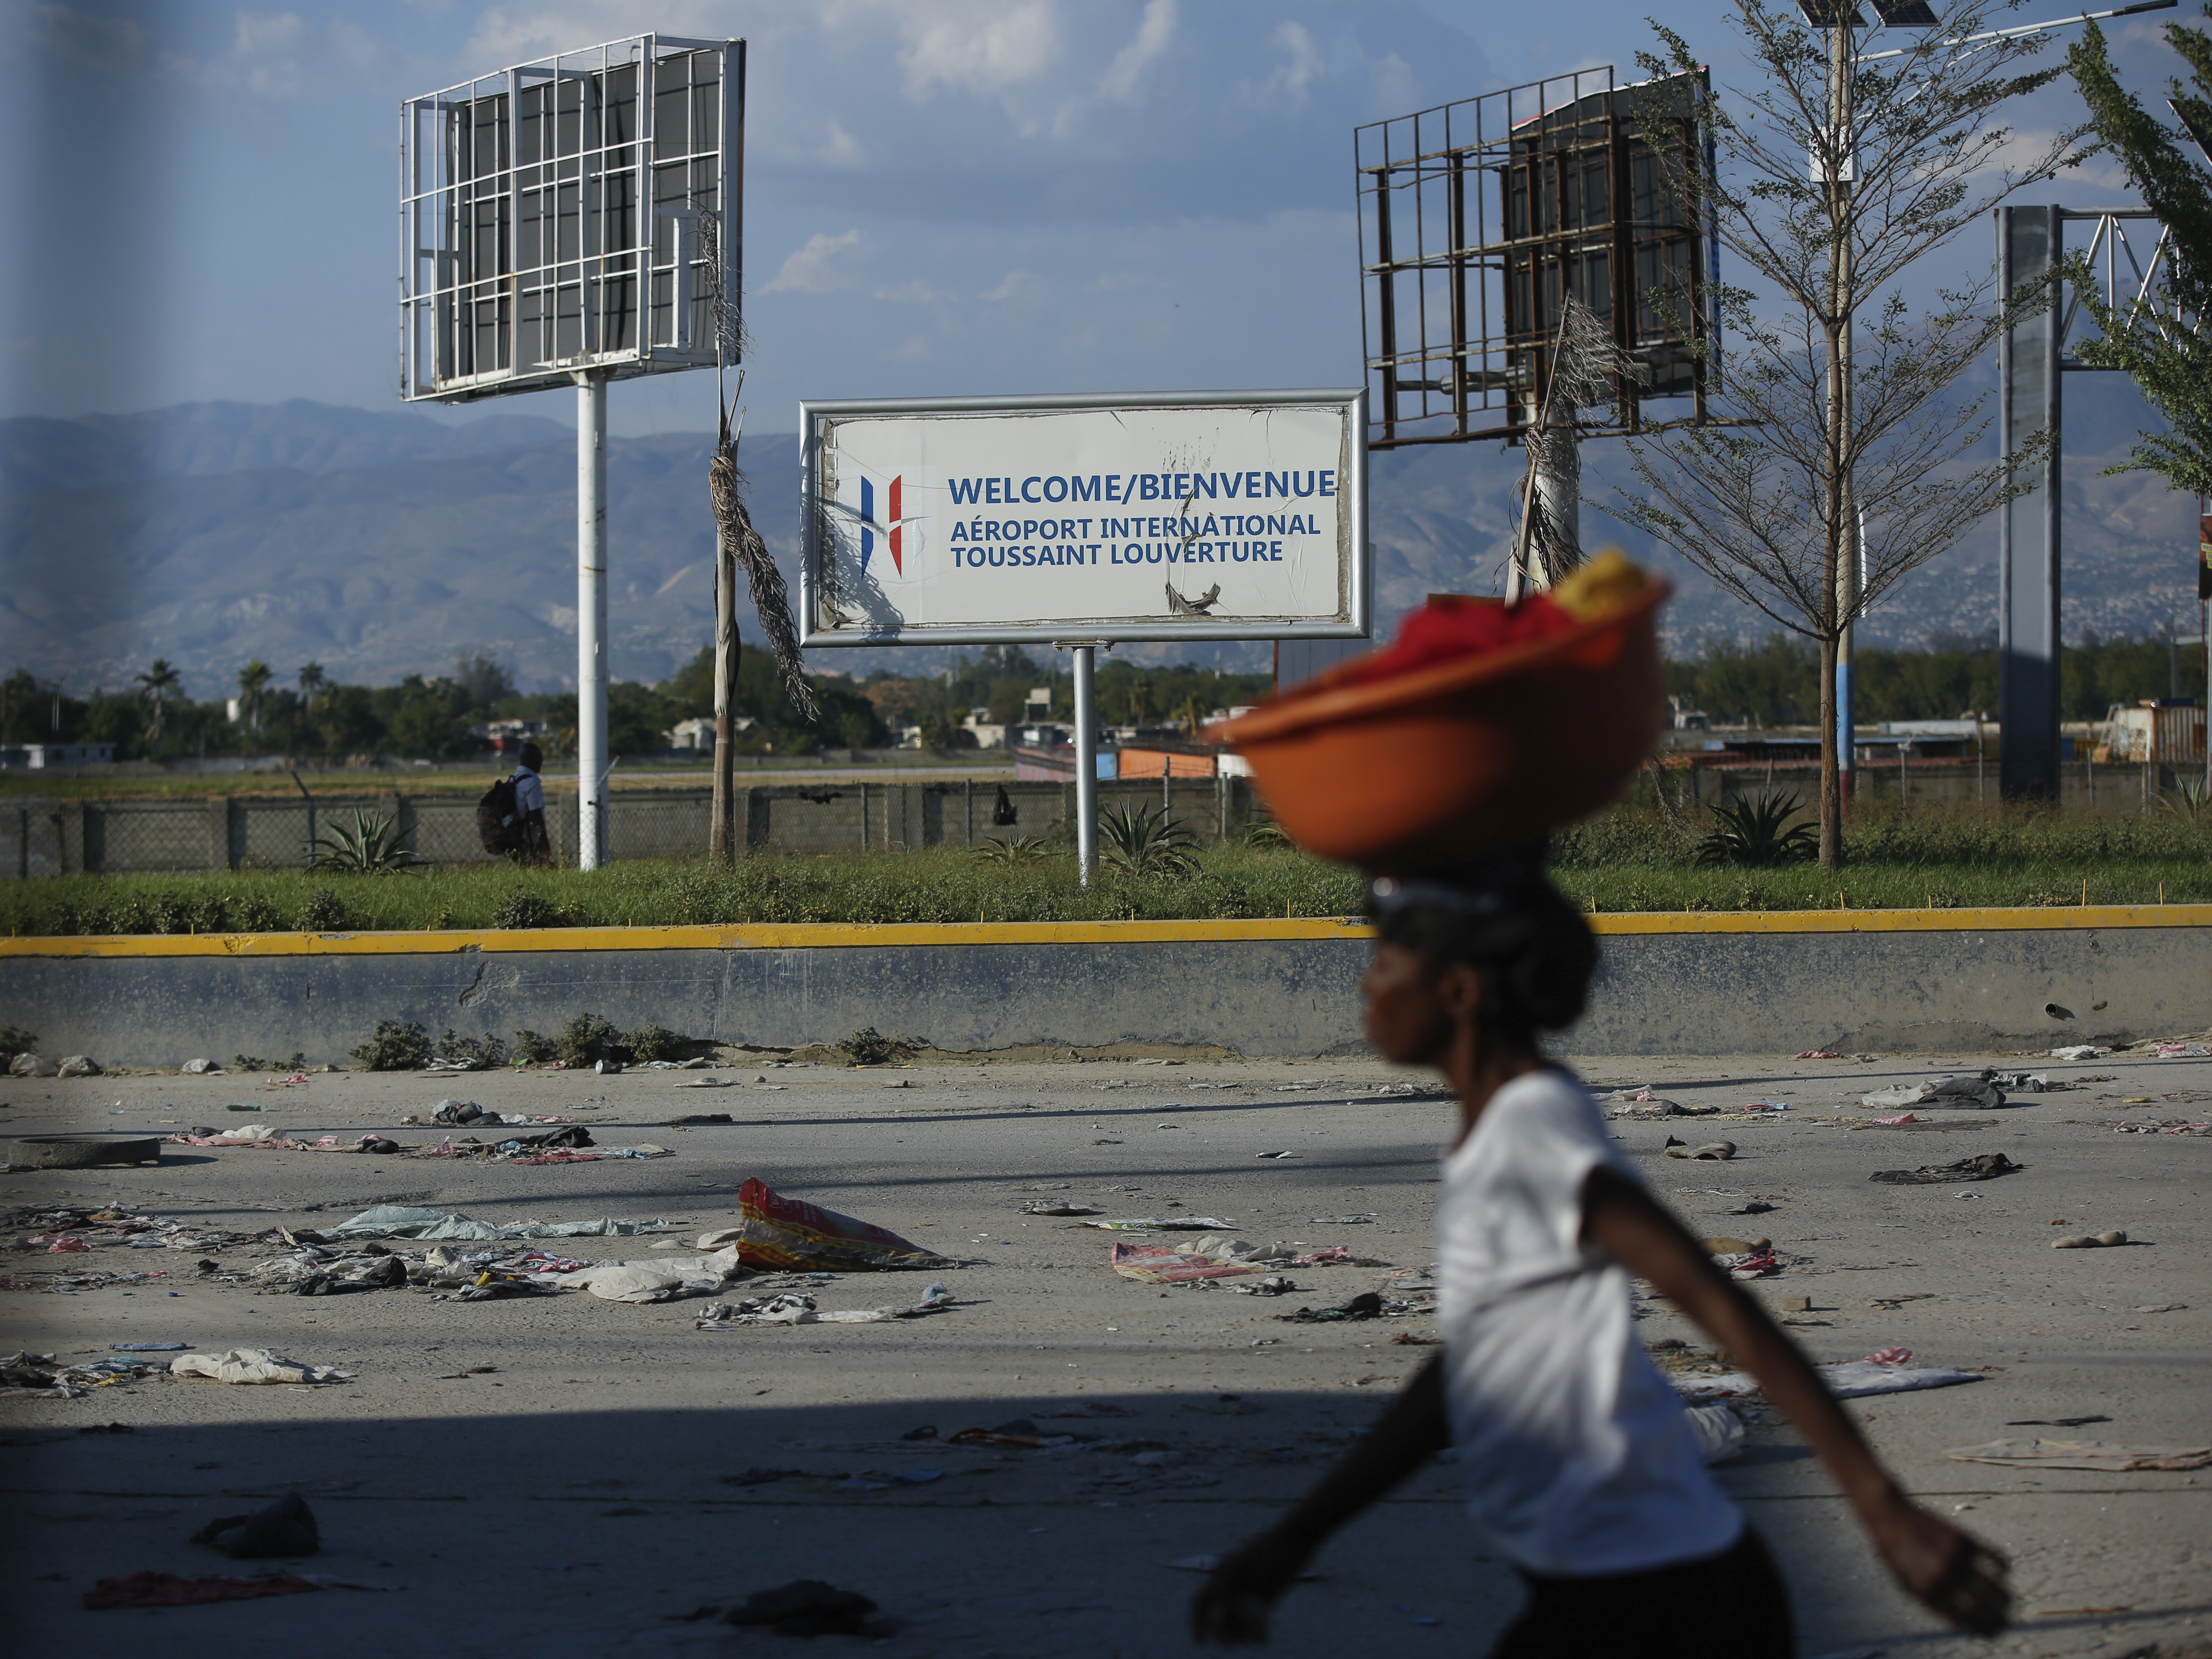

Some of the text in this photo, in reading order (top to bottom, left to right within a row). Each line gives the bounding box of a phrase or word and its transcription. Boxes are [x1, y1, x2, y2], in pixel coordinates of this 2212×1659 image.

[948, 470, 1335, 504] WELCOME/BIENVENUE
[950, 514, 1321, 542] AÉROPORT INTERNATIONAL
[950, 541, 1283, 568] TOUSSAINT LOUVERTURE
